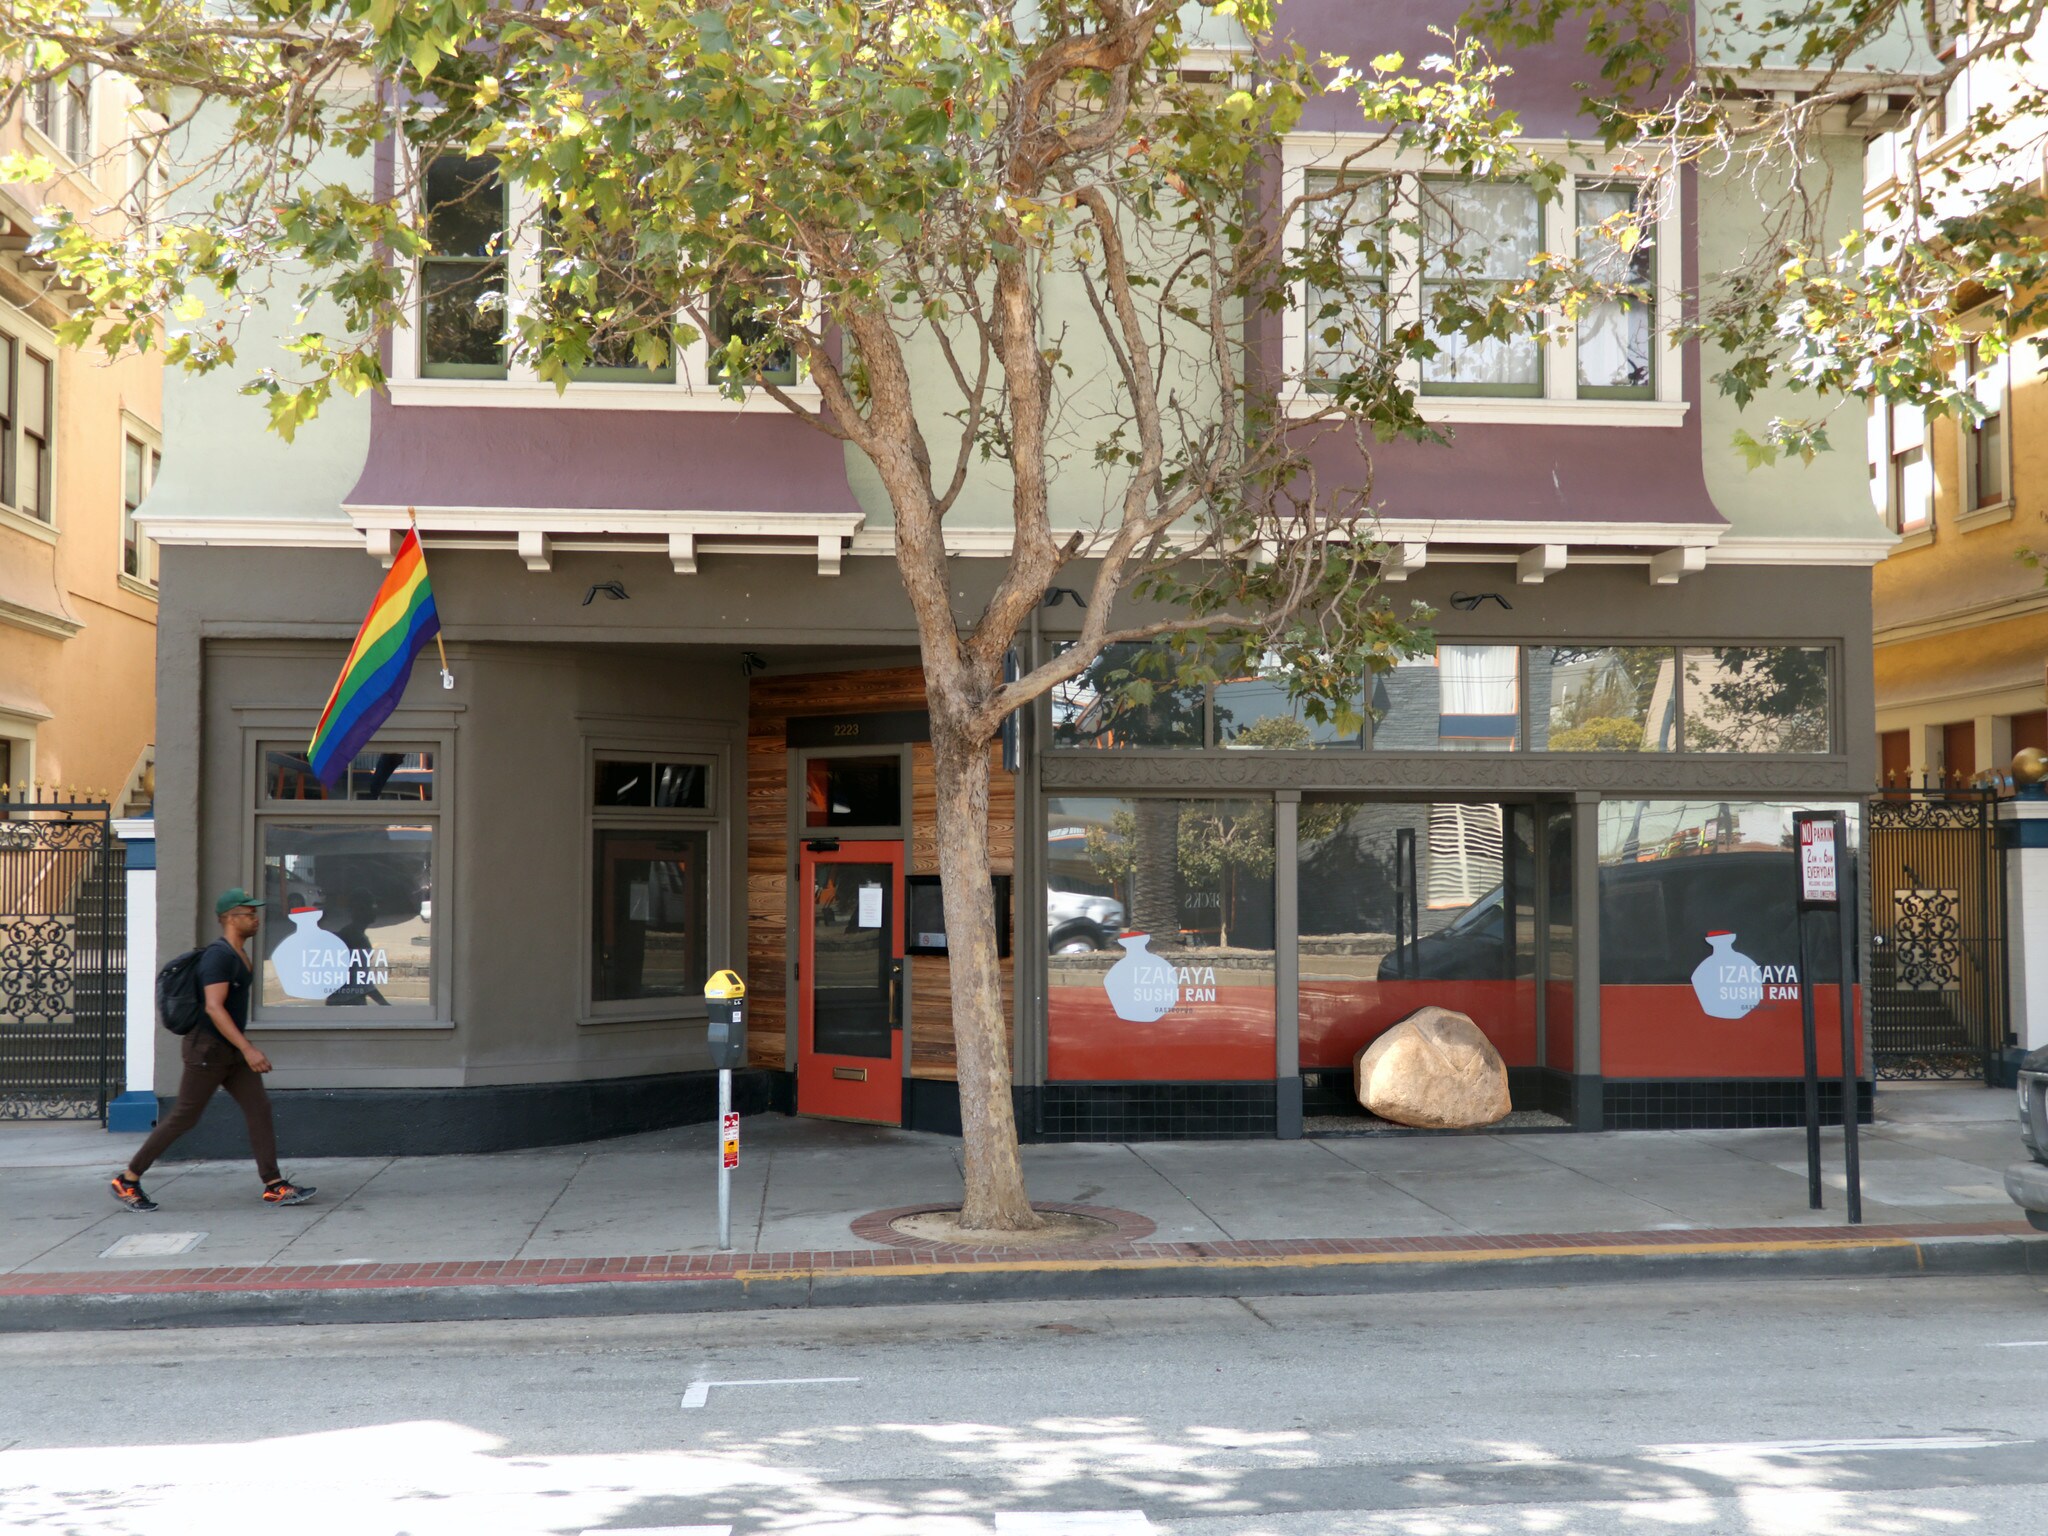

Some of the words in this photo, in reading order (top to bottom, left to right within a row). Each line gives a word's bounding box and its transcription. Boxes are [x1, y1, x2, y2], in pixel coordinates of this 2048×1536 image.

[834, 724, 859, 736] 2223
[1801, 822, 1812, 843] NO
[1813, 827, 1834, 842] PARKIN
[1807, 866, 1834, 879] EVERYDAY
[302, 949, 389, 968] IZAKAYA
[302, 971, 350, 985] SUSHI
[356, 971, 388, 985] RAN
[1133, 966, 1216, 985] IZAKAYA
[1720, 965, 1798, 984] IZAKAYA
[1133, 988, 1179, 1002] SUSHI
[1185, 988, 1216, 1002] RAN
[1720, 986, 1764, 1000] SUSHI
[1769, 986, 1798, 1000] RAN
